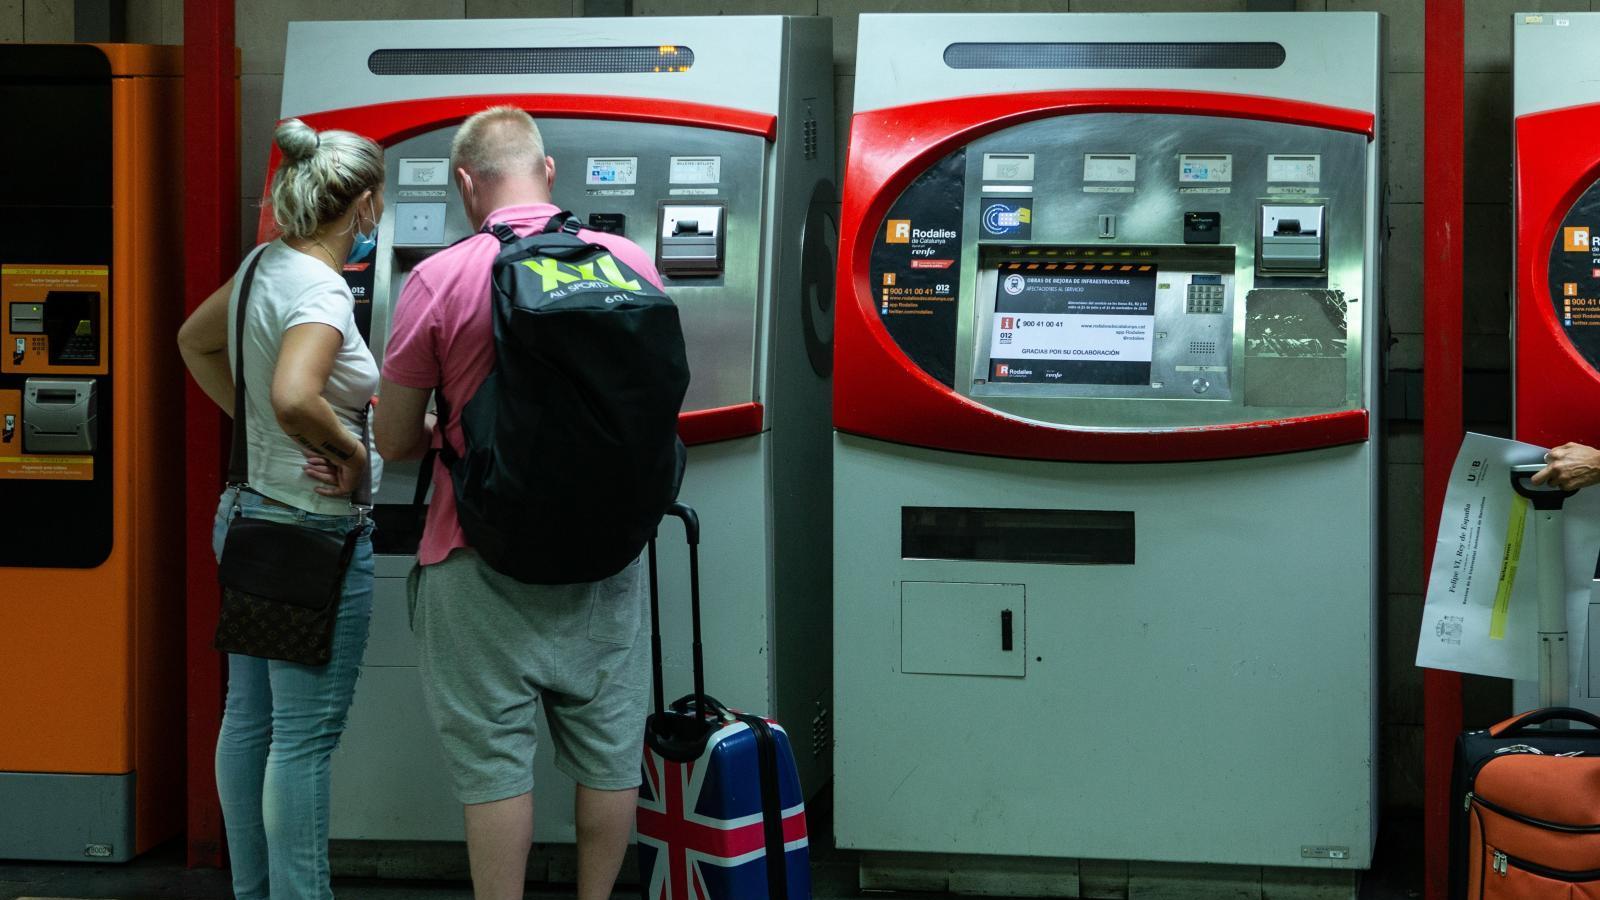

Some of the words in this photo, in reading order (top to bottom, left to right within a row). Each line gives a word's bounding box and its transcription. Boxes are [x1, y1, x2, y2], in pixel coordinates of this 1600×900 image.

[895, 223, 909, 238] R
[912, 229, 957, 239] Rodalies
[1573, 230, 1589, 246] R
[911, 247, 936, 257] renfe
[351, 286, 366, 294] 012
[550, 290, 568, 299] ALL
[567, 280, 610, 292] SPORTS
[604, 293, 634, 304] 60L
[1045, 320, 1055, 328] 00
[1055, 320, 1064, 328] 41
[1021, 347, 1048, 355] GRACIAS
[1072, 348, 1121, 357] COLABORACIÓN
[1448, 570, 1459, 593] Felipe
[1461, 503, 1471, 530] España
